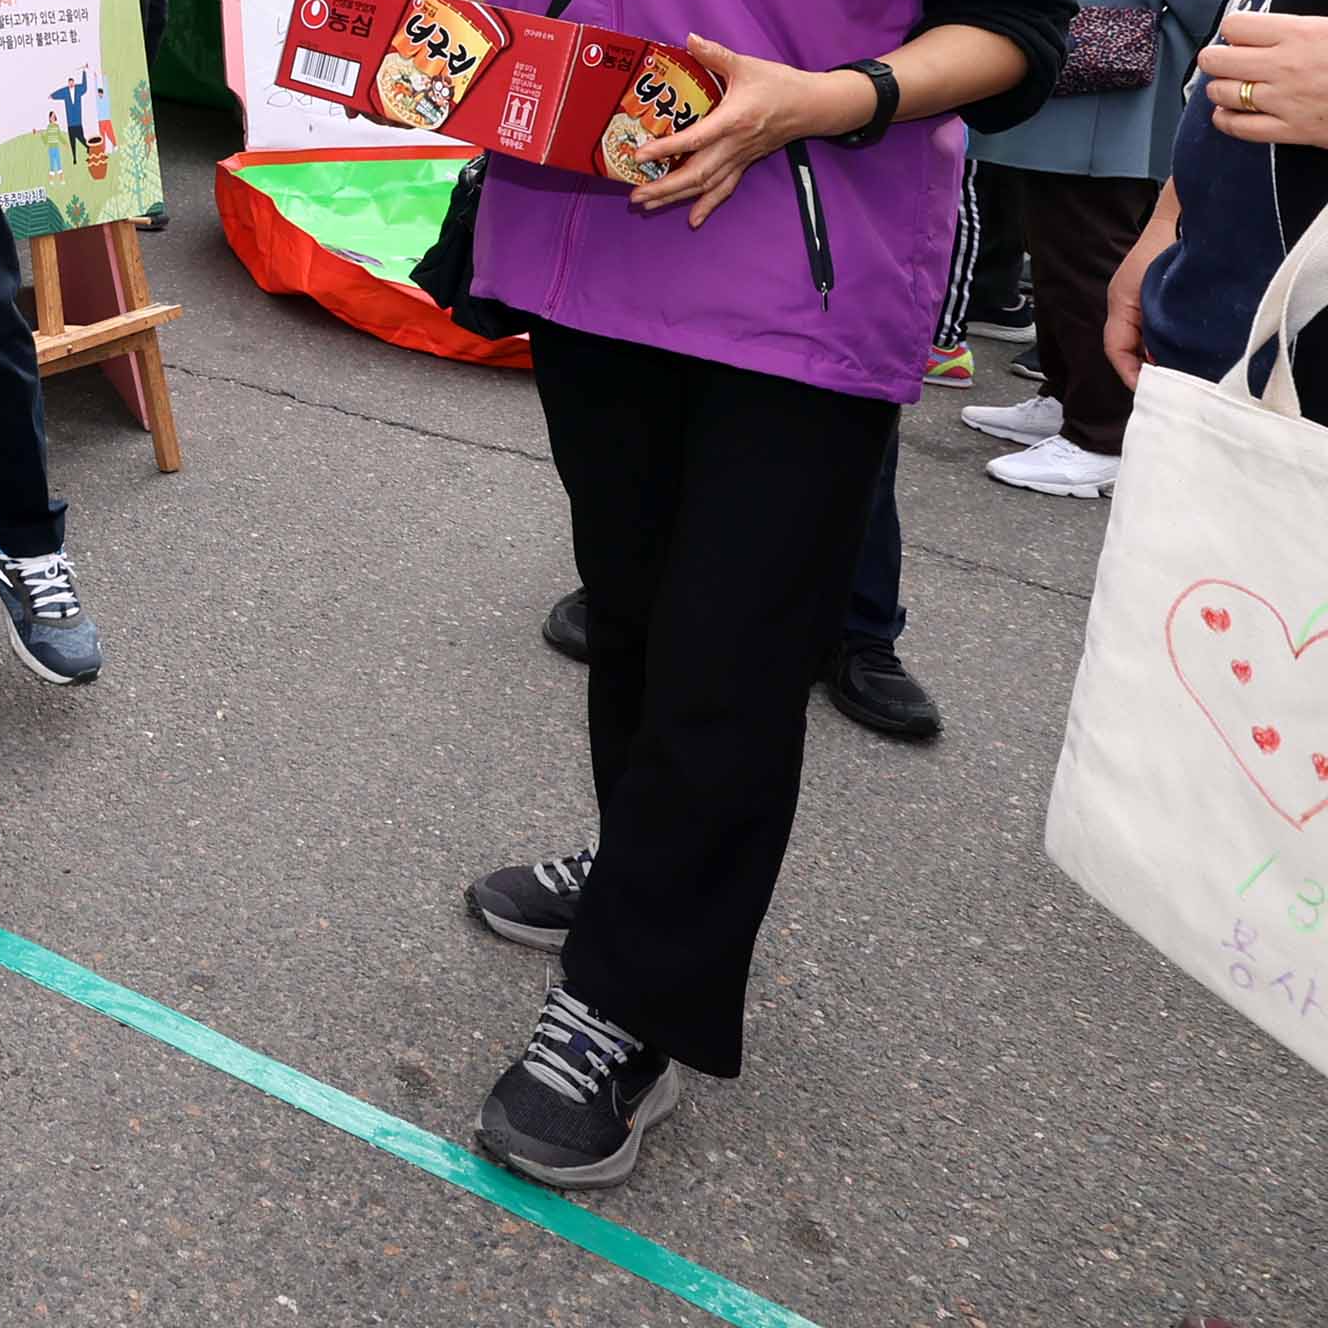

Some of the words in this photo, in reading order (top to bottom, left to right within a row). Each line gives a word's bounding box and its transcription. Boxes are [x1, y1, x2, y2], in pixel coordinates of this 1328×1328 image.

[58, 7, 89, 23] 고을이라
[328, 7, 374, 39] 농심
[405, 14, 477, 76] 너구리
[635, 72, 700, 134] 너구리
